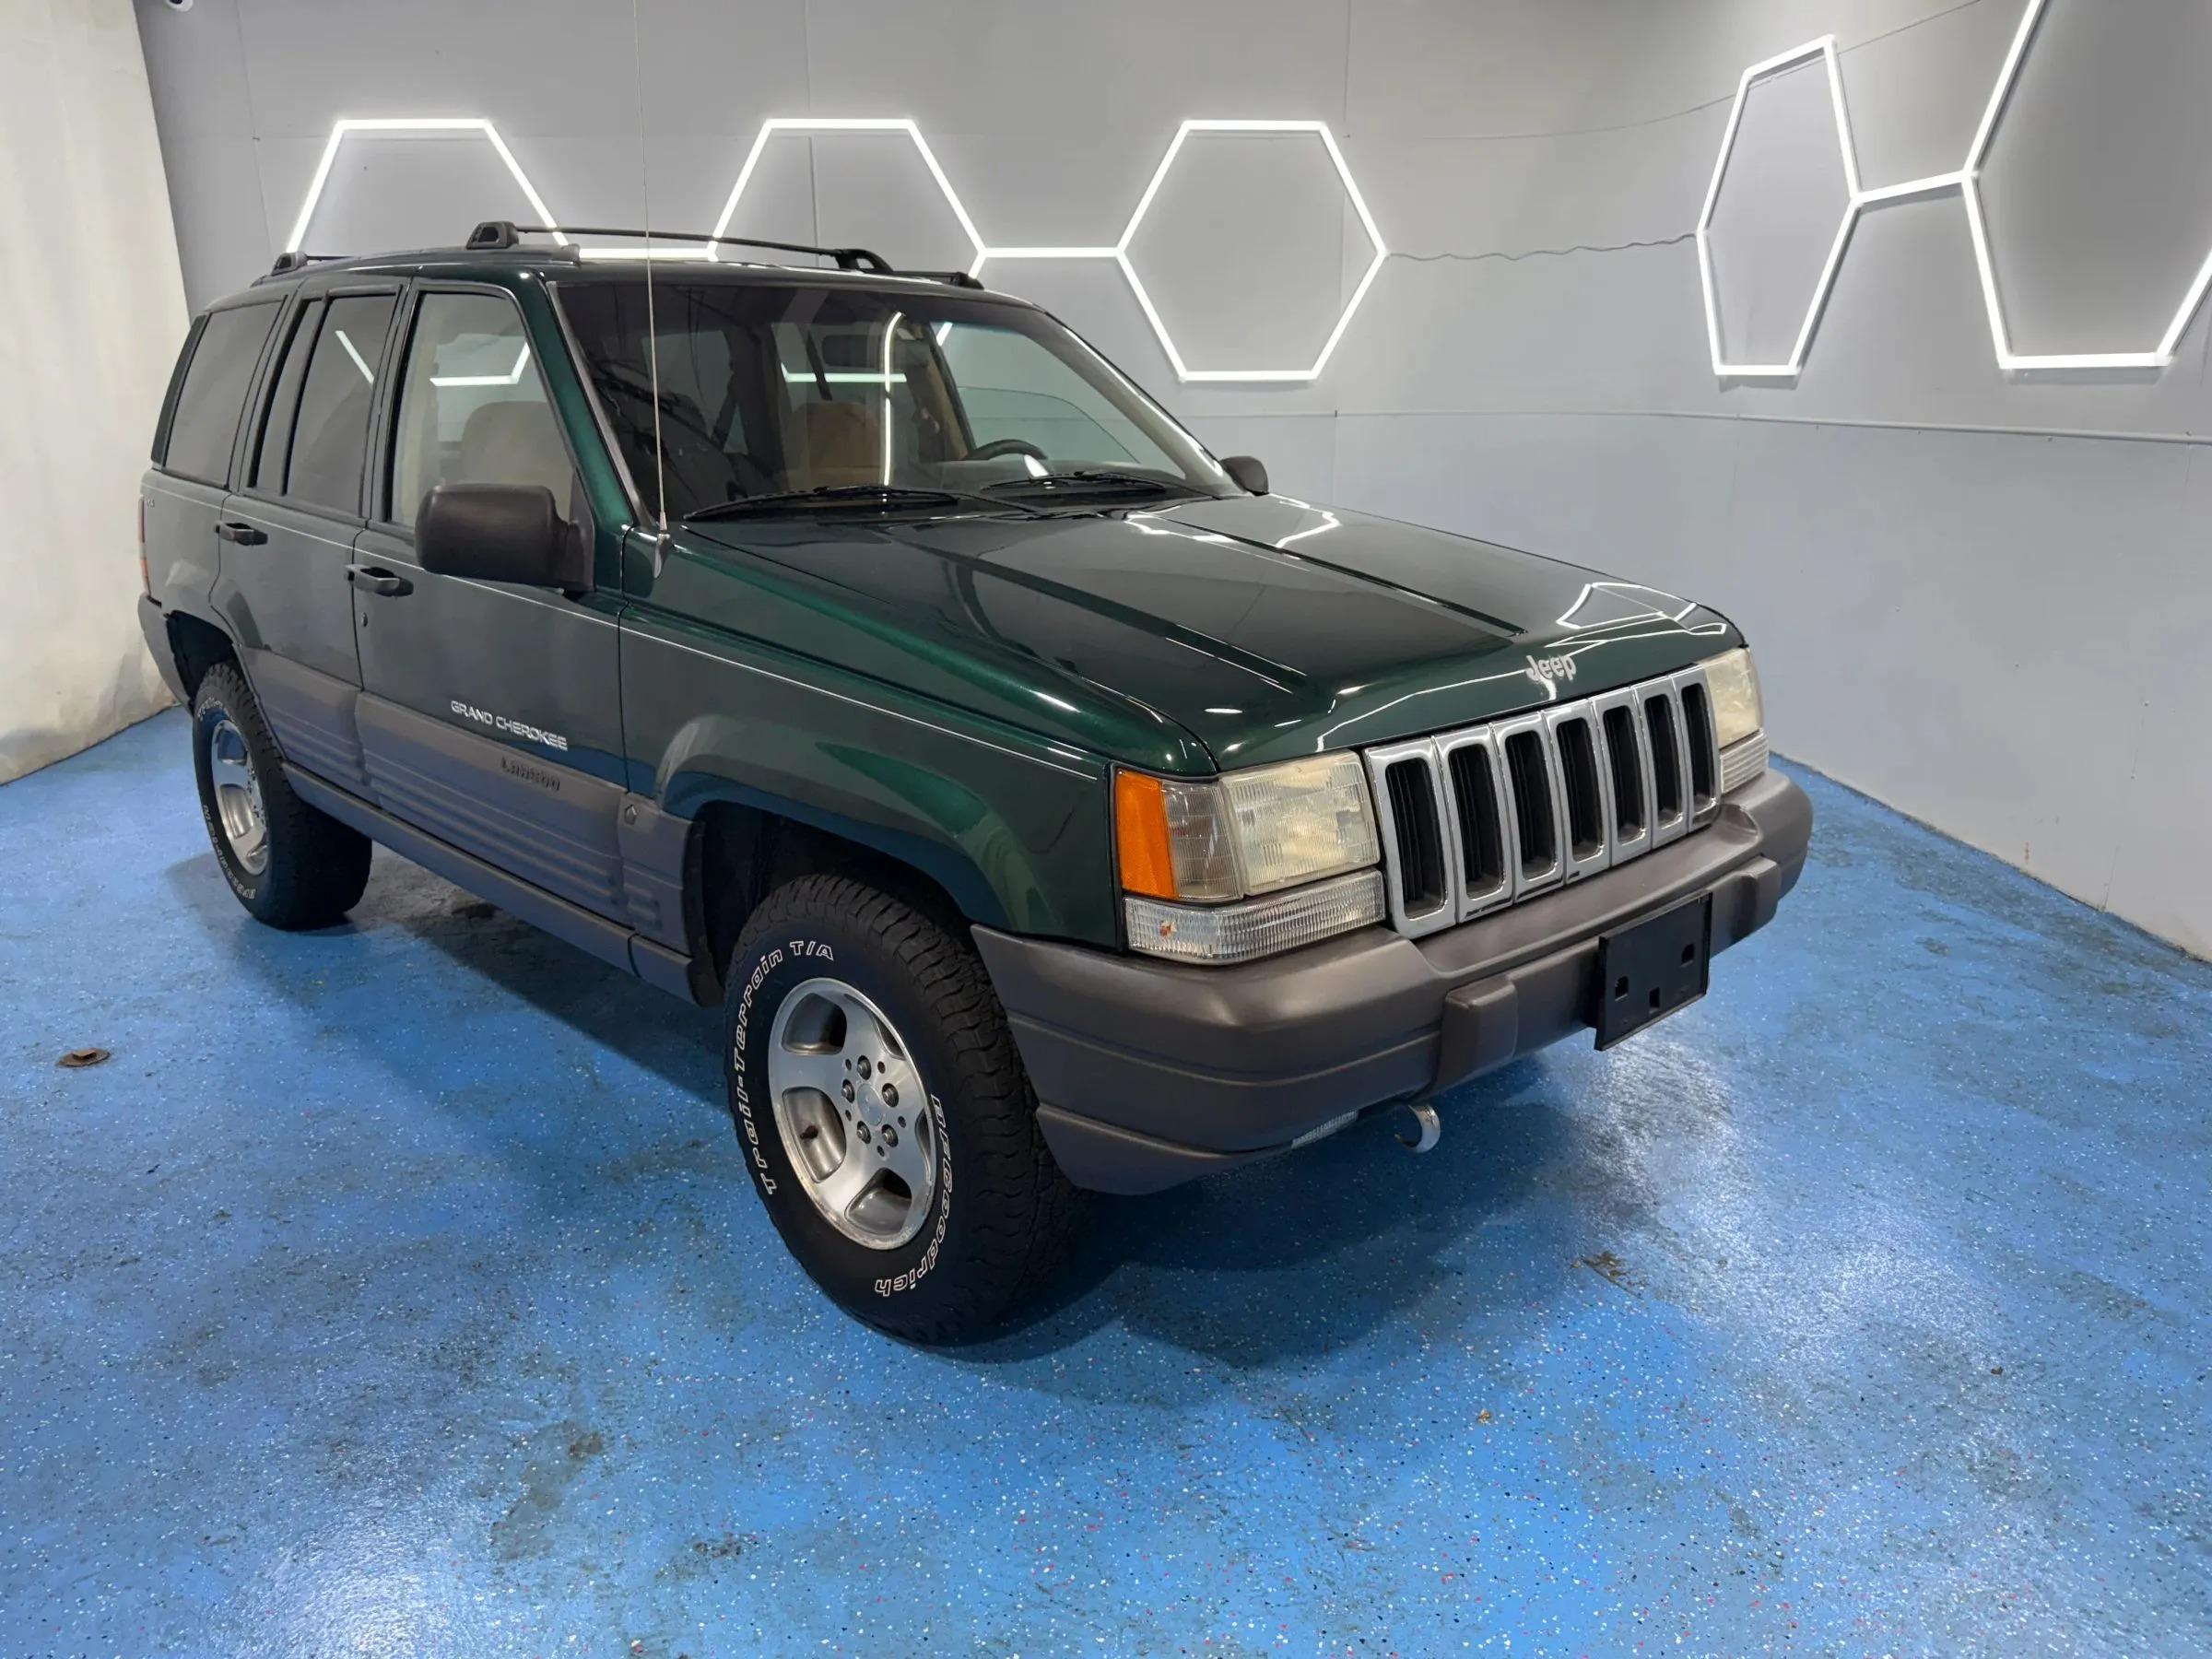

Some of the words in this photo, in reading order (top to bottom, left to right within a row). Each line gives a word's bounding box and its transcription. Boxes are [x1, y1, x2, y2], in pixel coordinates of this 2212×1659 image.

[1526, 654, 1577, 682] Jeep
[451, 700, 493, 725] GRAND
[496, 716, 568, 751] CHEROKEE
[790, 940, 834, 961] T/A
